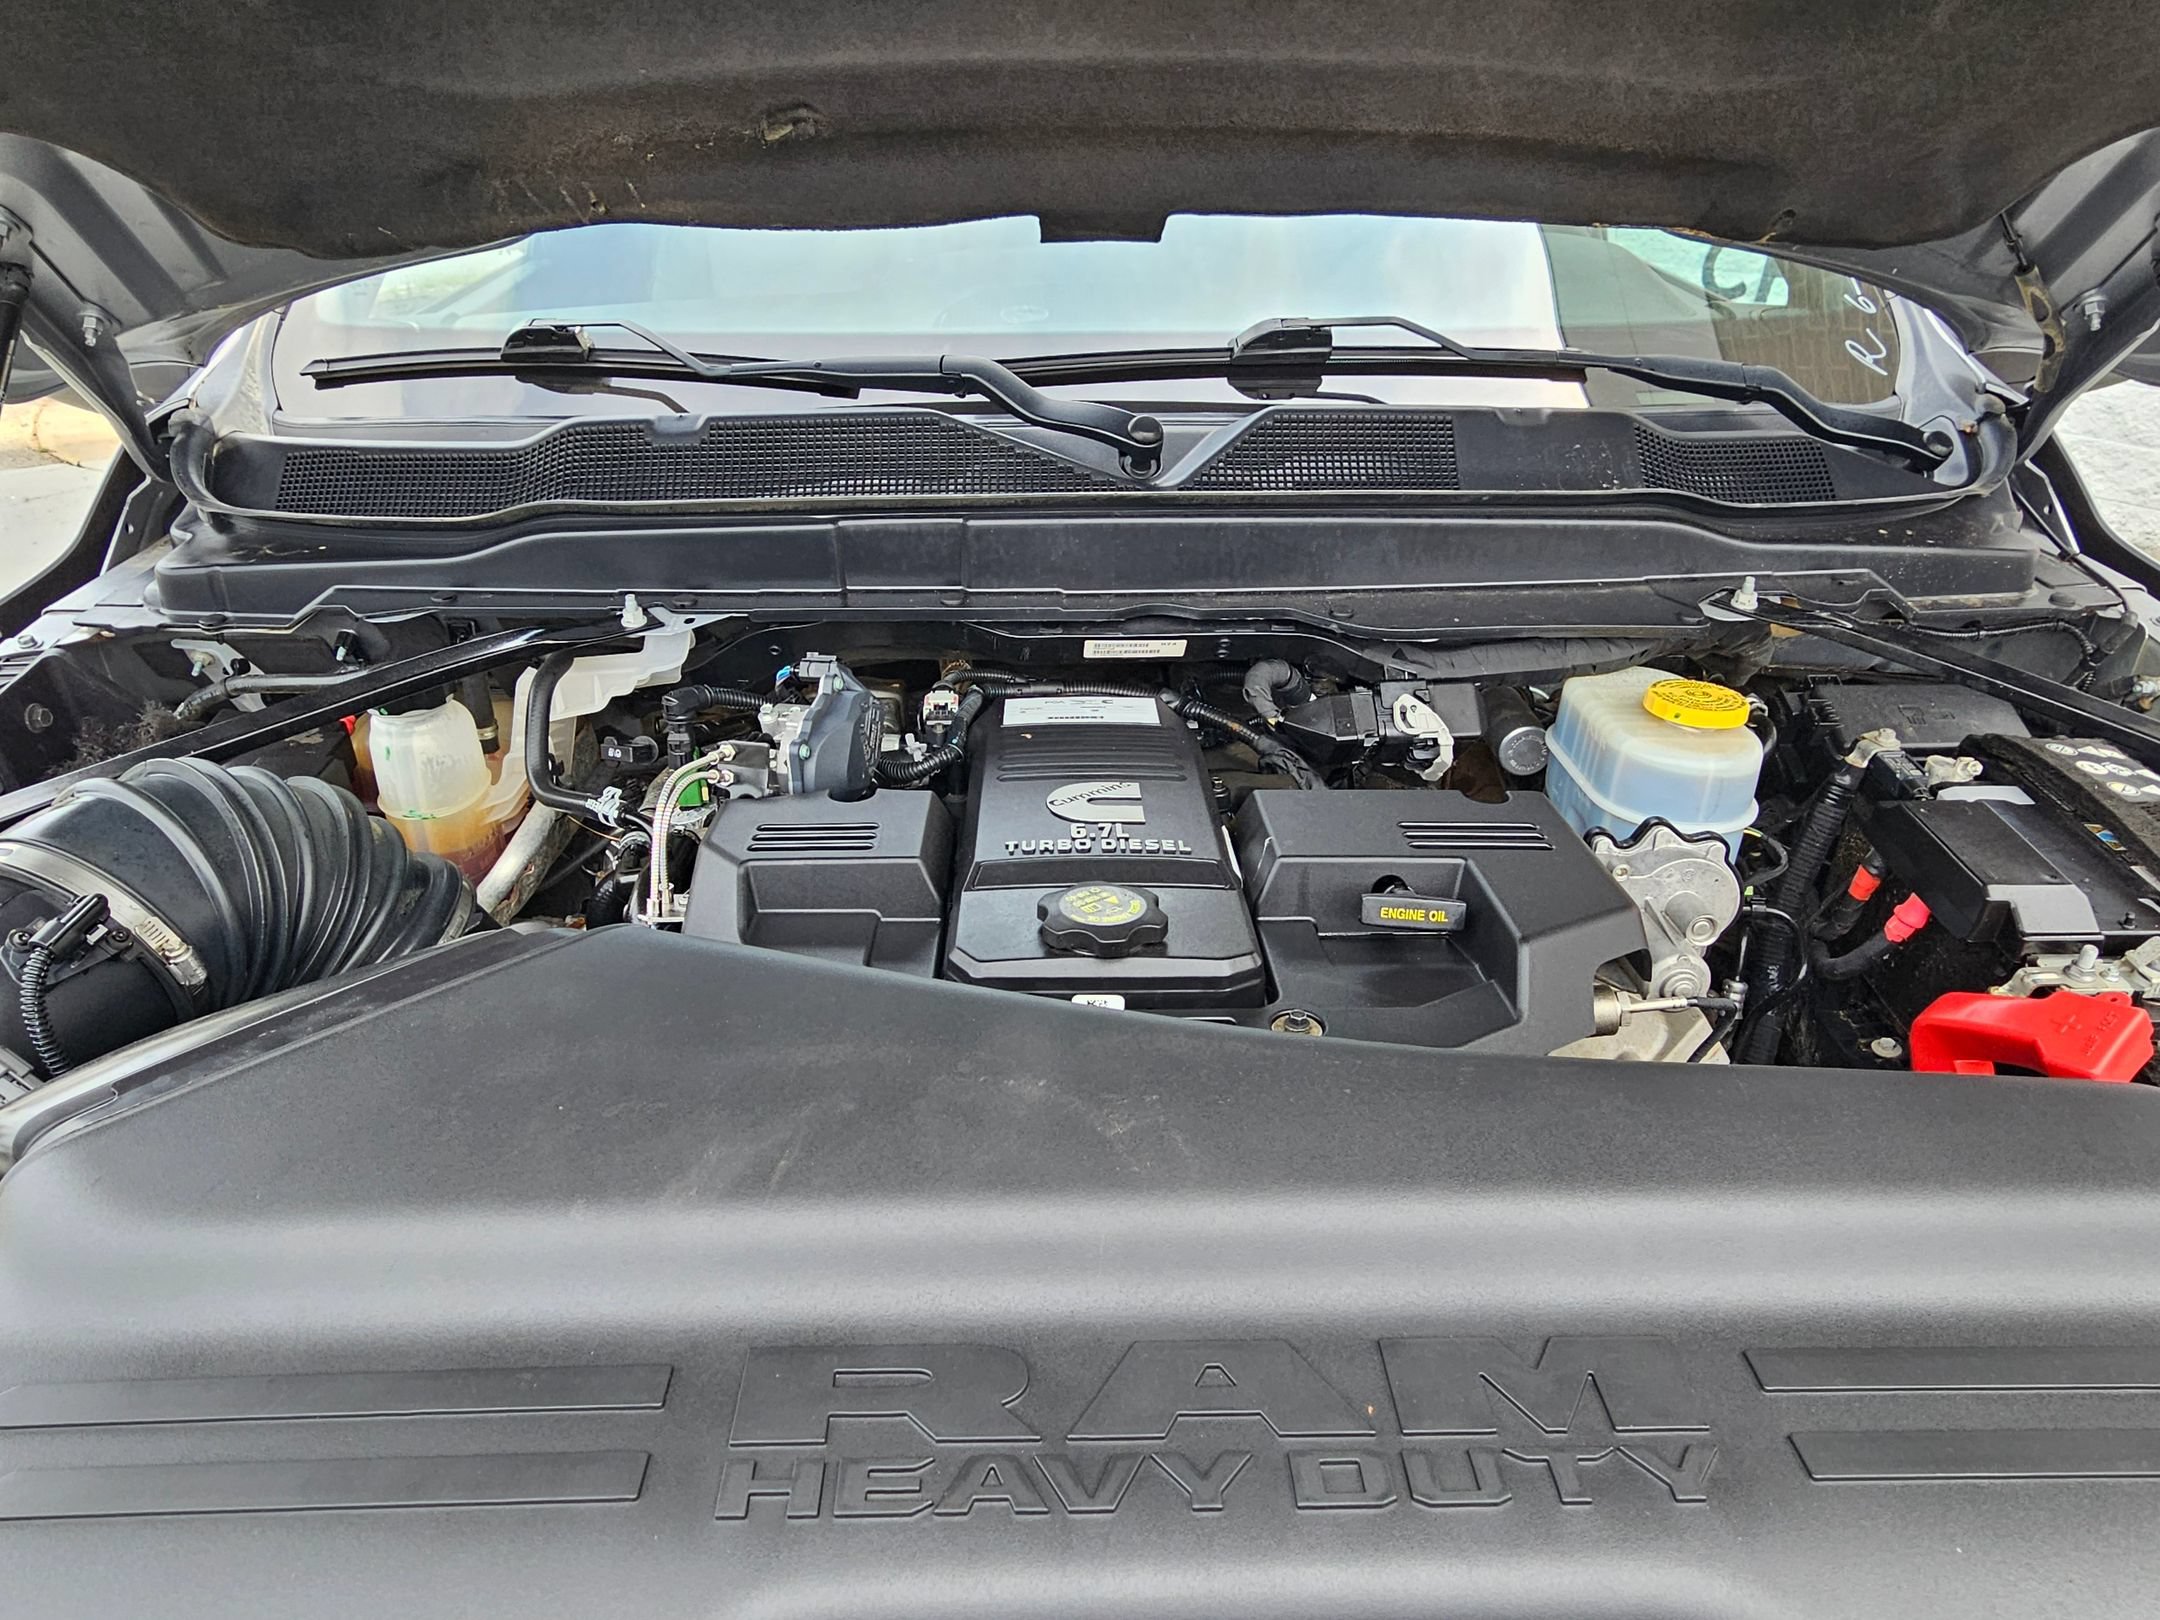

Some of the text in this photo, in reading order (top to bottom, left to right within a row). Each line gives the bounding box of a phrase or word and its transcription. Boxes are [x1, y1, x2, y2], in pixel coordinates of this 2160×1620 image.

[1070, 822, 1130, 841] 6.7L
[1005, 838, 1193, 856] TURBO DIESEL
[1380, 907, 1449, 923] ENGINE OIL
[728, 1335, 1712, 1448] RAM
[713, 1444, 1719, 1520] HEAVY DUTY
